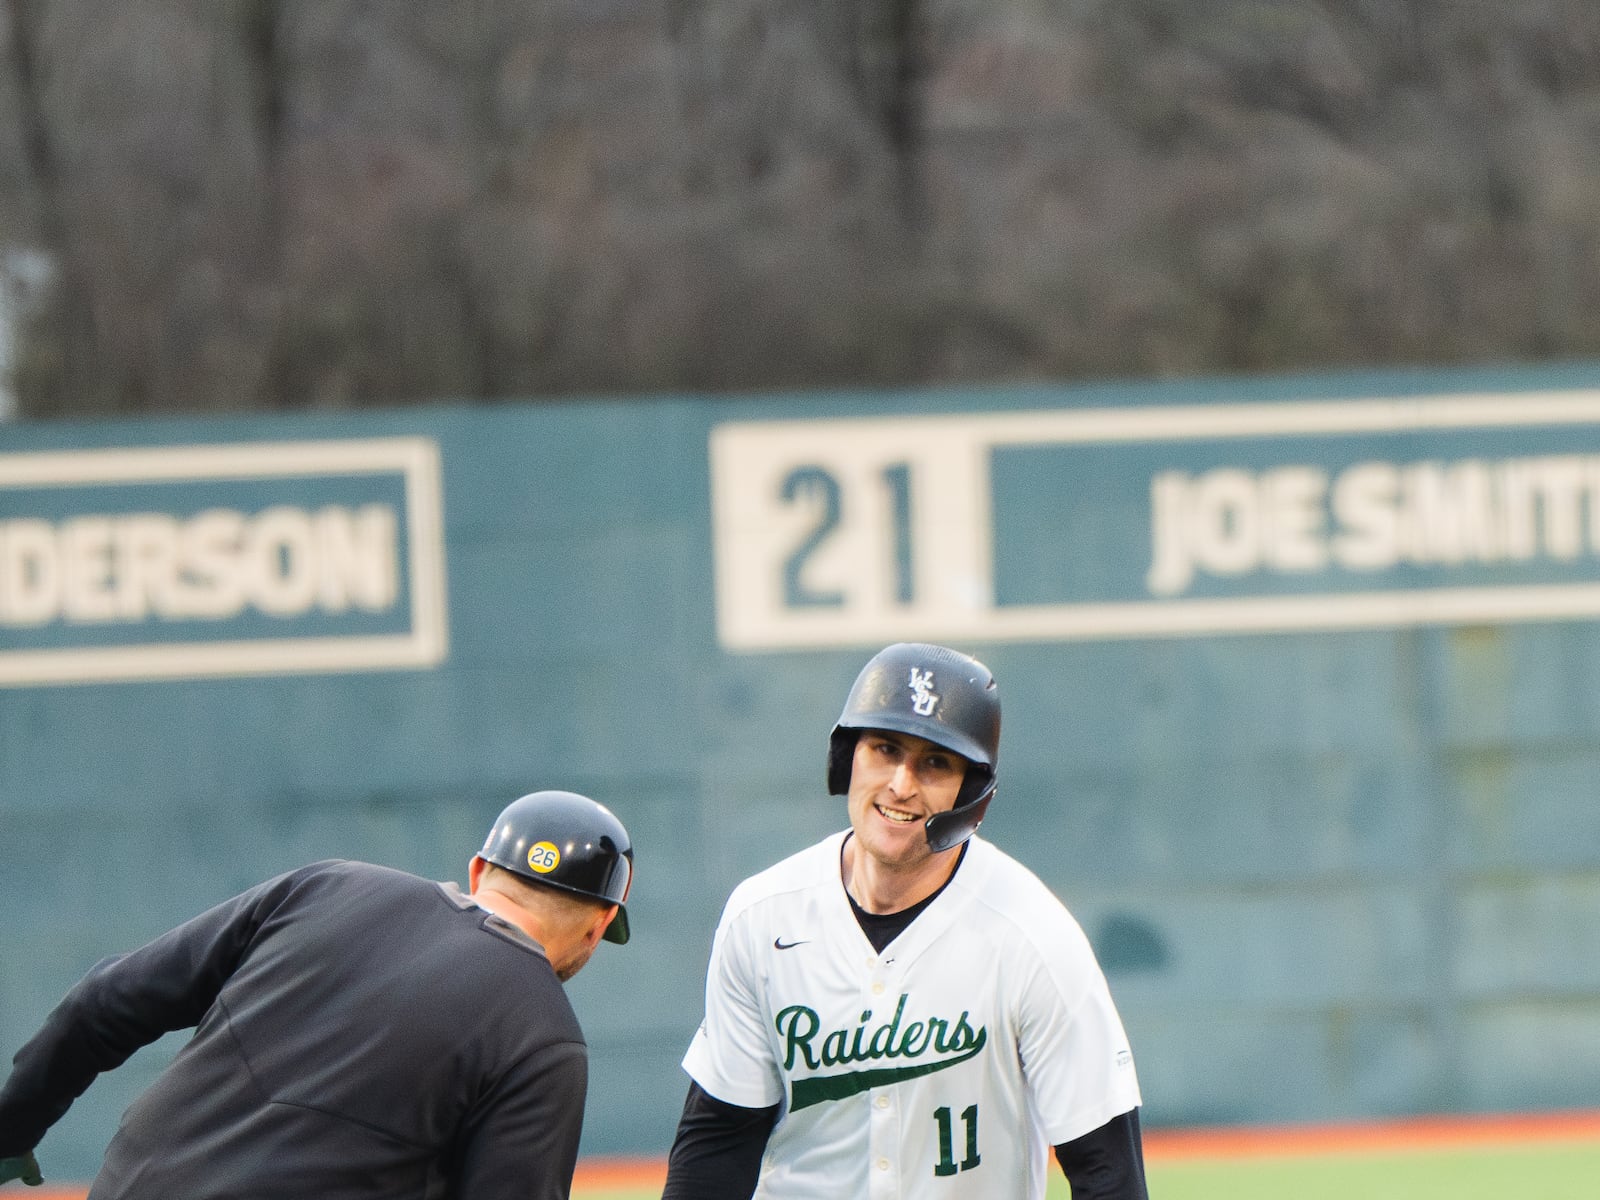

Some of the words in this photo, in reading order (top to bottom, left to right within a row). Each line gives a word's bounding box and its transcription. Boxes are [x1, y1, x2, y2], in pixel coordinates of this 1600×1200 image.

[778, 463, 915, 608] 21
[1147, 466, 1326, 595] JOE
[1331, 453, 1600, 572] SMIT
[531, 847, 557, 868] 26
[775, 993, 987, 1072] Raiders
[933, 1103, 982, 1177] 11
